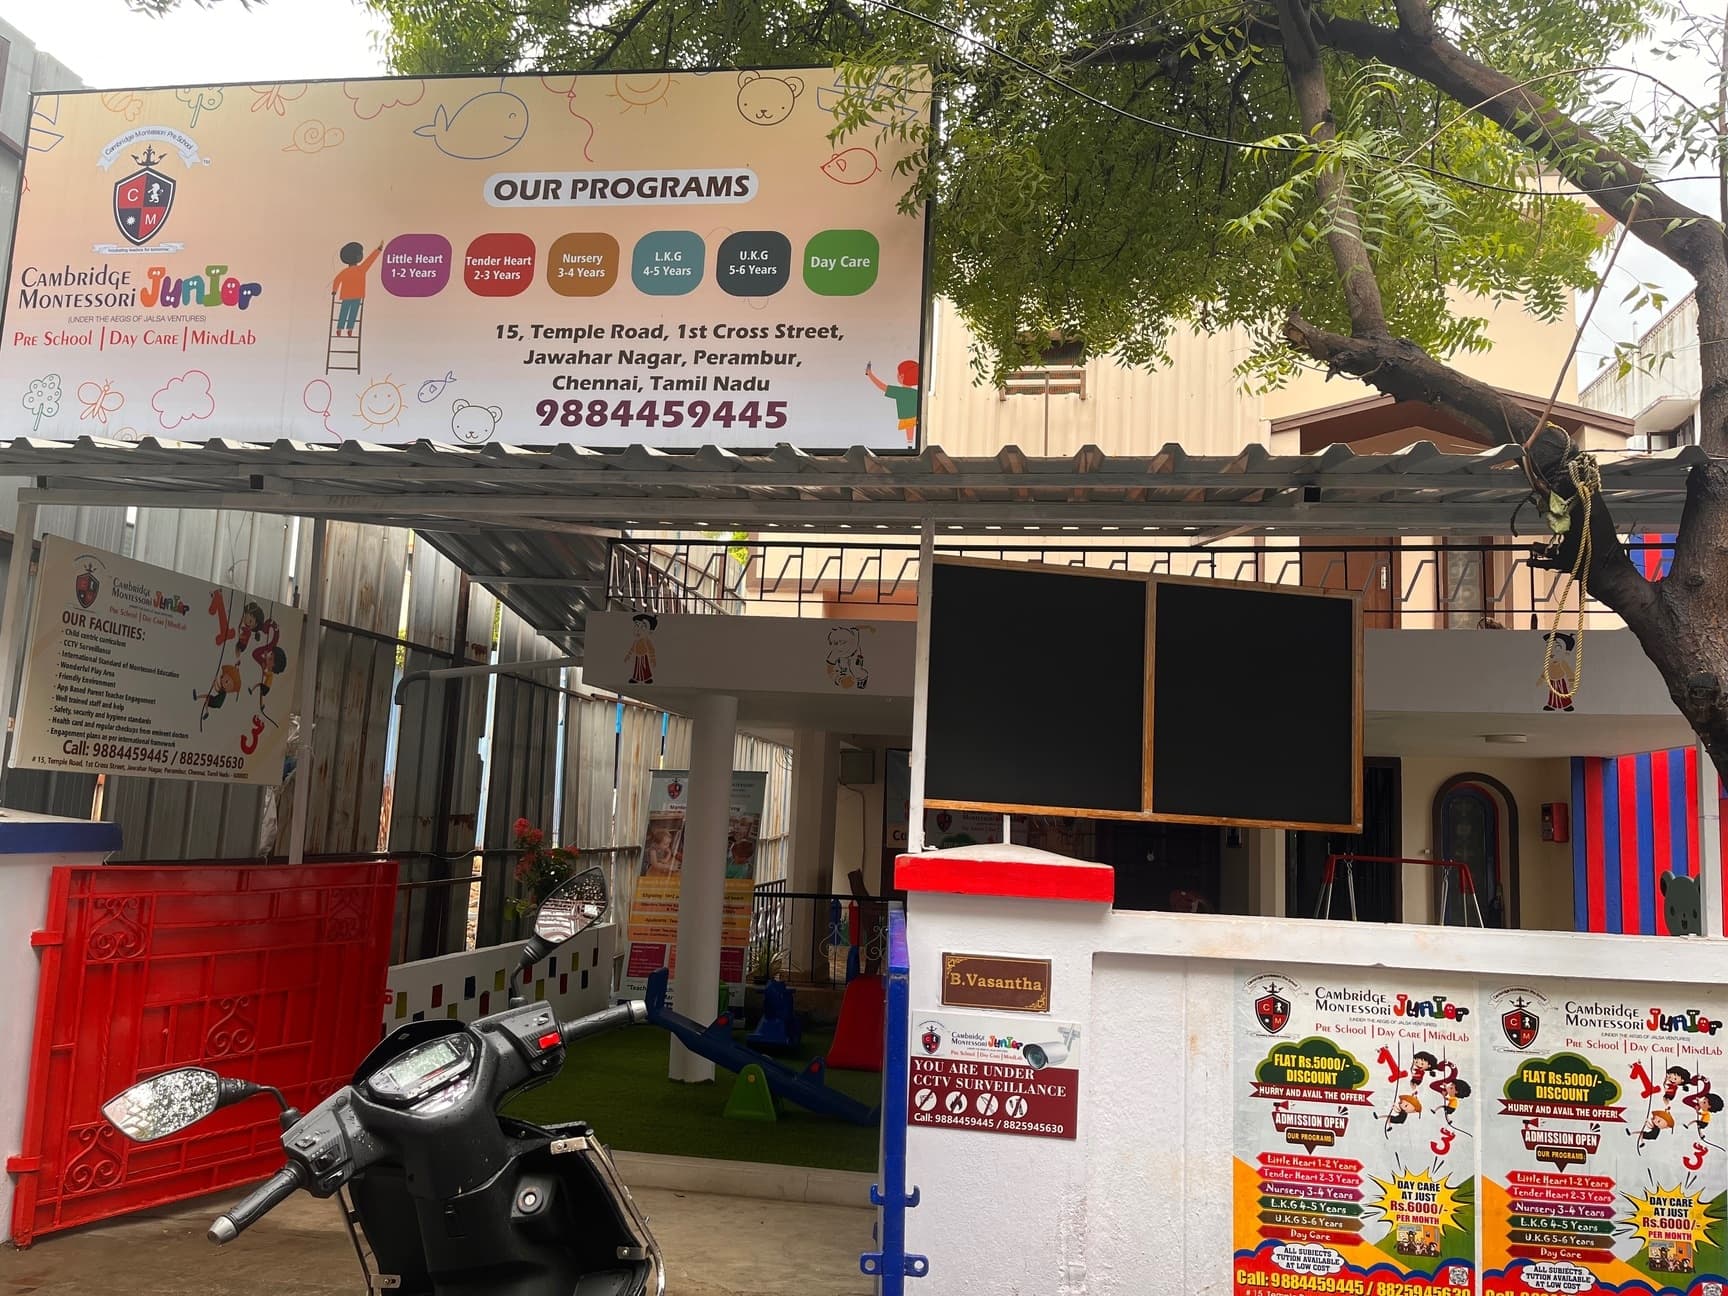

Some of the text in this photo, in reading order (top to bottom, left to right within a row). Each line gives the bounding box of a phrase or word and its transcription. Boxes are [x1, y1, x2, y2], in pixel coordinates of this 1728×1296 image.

[127, 188, 139, 201] C
[493, 175, 750, 201] OUR PROGRAMS
[145, 213, 157, 225] M
[387, 253, 443, 264] Little Heart
[466, 255, 532, 266] Tender Heart
[562, 253, 603, 267] Nursery
[654, 251, 682, 262] L.K.G
[739, 250, 769, 261] U.K.G
[811, 255, 870, 271] Day Care
[391, 268, 437, 278] 1-2 Years
[473, 270, 521, 280] 2-3 Years
[557, 267, 605, 277] 3-4 Years
[643, 266, 692, 276] 4-5 Years
[729, 265, 777, 275] 5-6 Years
[68, 315, 207, 324] (UNDER THE AEGIS OF JALSA VENTURES)
[495, 323, 845, 343] 15, Temple Road, 1st Cross Street,
[523, 350, 802, 369] Jawahar Nagar, Perambur,
[552, 375, 770, 393] Chennai, Tamil Nadu
[535, 399, 788, 429] 9884459445
[62, 611, 86, 628] OUR
[89, 616, 146, 641] FACILITIES:
[64, 639, 111, 655] CCTV Surveillance
[60, 661, 115, 678] Wonderful Play Area
[58, 672, 116, 688] Friendly Environment
[63, 740, 90, 757] Call:
[92, 742, 169, 764] 9884459445
[179, 751, 245, 770] 8825945630
[914, 1059, 1035, 1080] YOU ARE UNDER
[1274, 1054, 1350, 1071] FLAT Rs.5000/-
[1286, 1069, 1338, 1085] DISCOUNT
[1523, 1070, 1602, 1087] FLAT Rs.5000/-
[913, 1074, 1066, 1097] CCTV SURVEILLANCE
[1536, 1085, 1590, 1102] DISCOUNT
[1259, 1086, 1366, 1102] HURRY AND AVAIL THE OFFER!
[914, 1112, 933, 1122] Call:
[935, 1114, 994, 1128] 9884459445
[1003, 1120, 1064, 1134] 8825945630
[1275, 1113, 1345, 1129] ADMISSION OPEN
[1267, 1154, 1357, 1170] Little Heart 1-2 Years
[1264, 1168, 1359, 1185] Tender Heart 2-3 Years
[1265, 1183, 1353, 1200] Nursery 3-4 Years
[1271, 1198, 1347, 1214] L.K.G 4-5 Years
[1650, 1197, 1693, 1207] DAY CARE
[1654, 1208, 1689, 1217] AT JUST
[1275, 1214, 1343, 1228] U.K.G 5-6 Years
[1643, 1217, 1701, 1230] Rs.6000/-
[1290, 1228, 1331, 1241] Day Care
[1665, 1231, 1692, 1240] MONTH
[1237, 1270, 1269, 1287] Call:
[1271, 1272, 1364, 1296] 9884459445
[1526, 1273, 1592, 1283] TUTION AVAILABLE
[1547, 1281, 1561, 1289] LOW
[1563, 1282, 1581, 1290] COST
